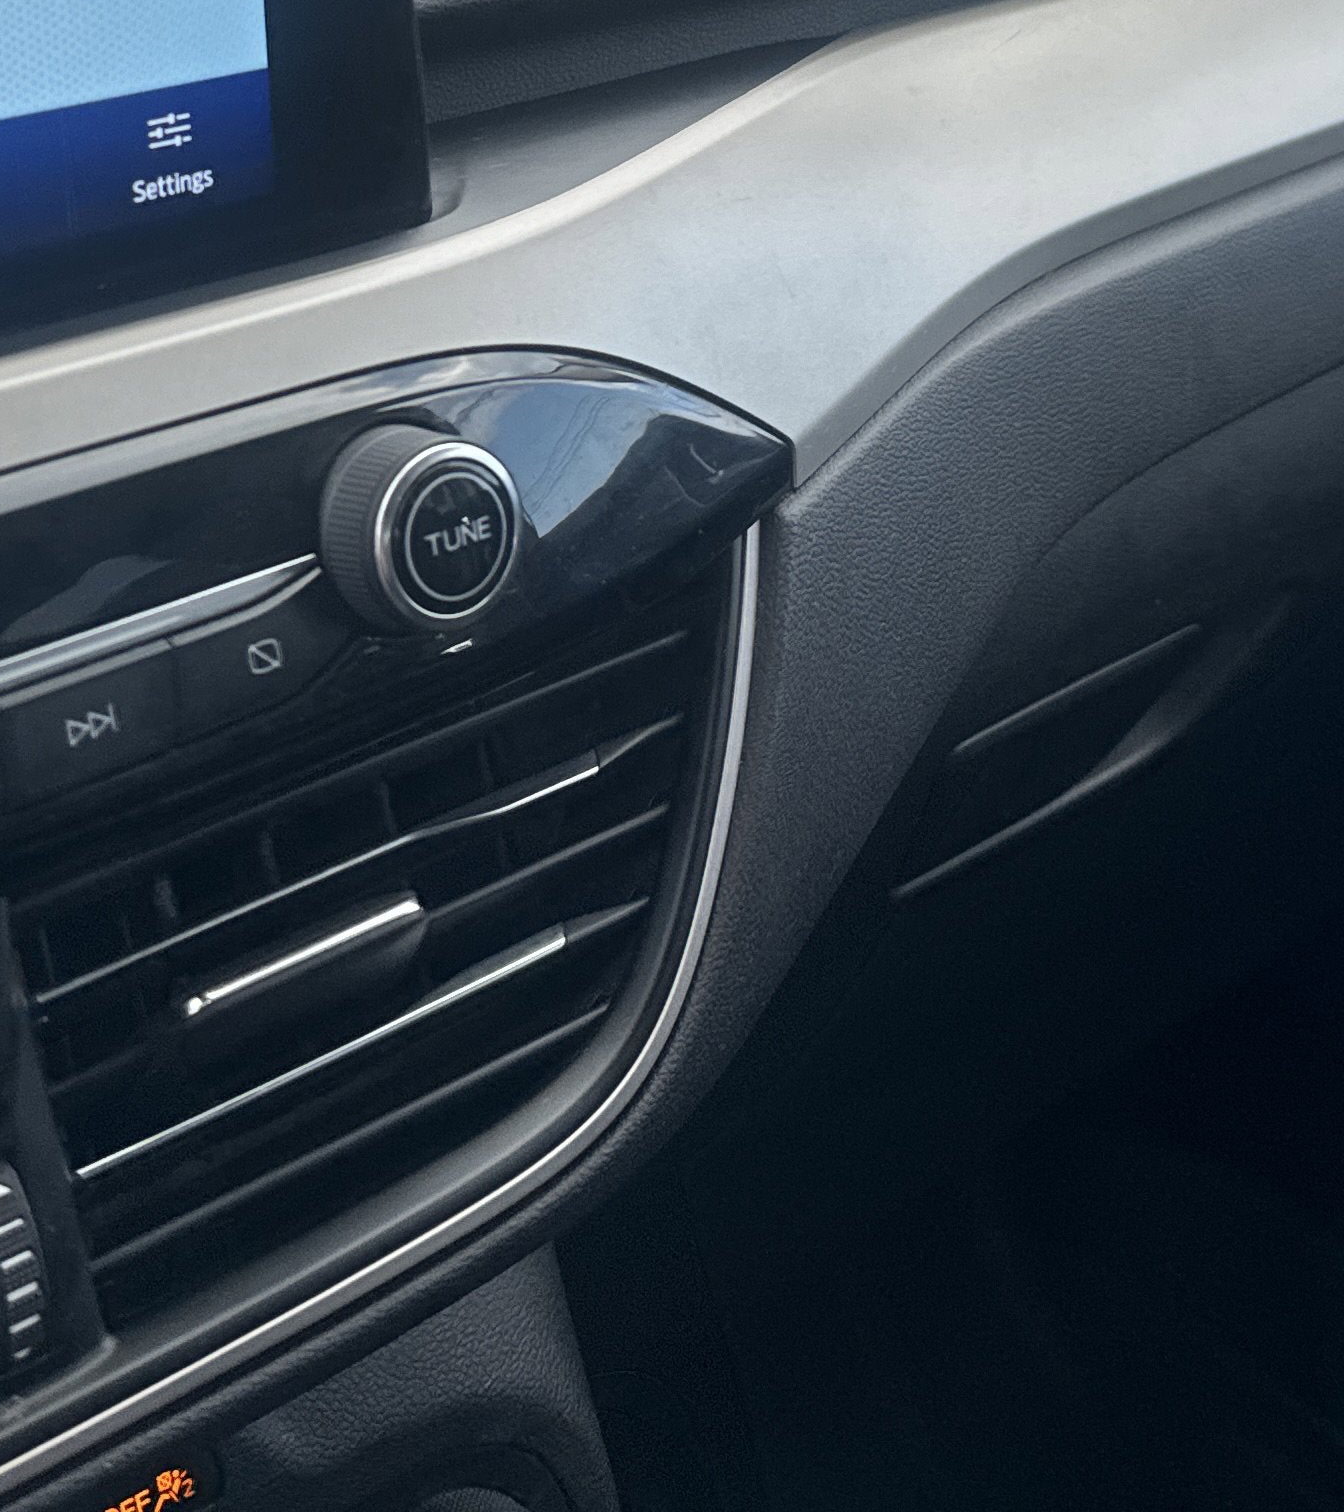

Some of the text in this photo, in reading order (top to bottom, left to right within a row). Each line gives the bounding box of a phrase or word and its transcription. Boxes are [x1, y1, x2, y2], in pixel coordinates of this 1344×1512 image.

[132, 167, 215, 204] Settings
[423, 515, 494, 557] TUNE
[104, 1488, 152, 1512] FF
